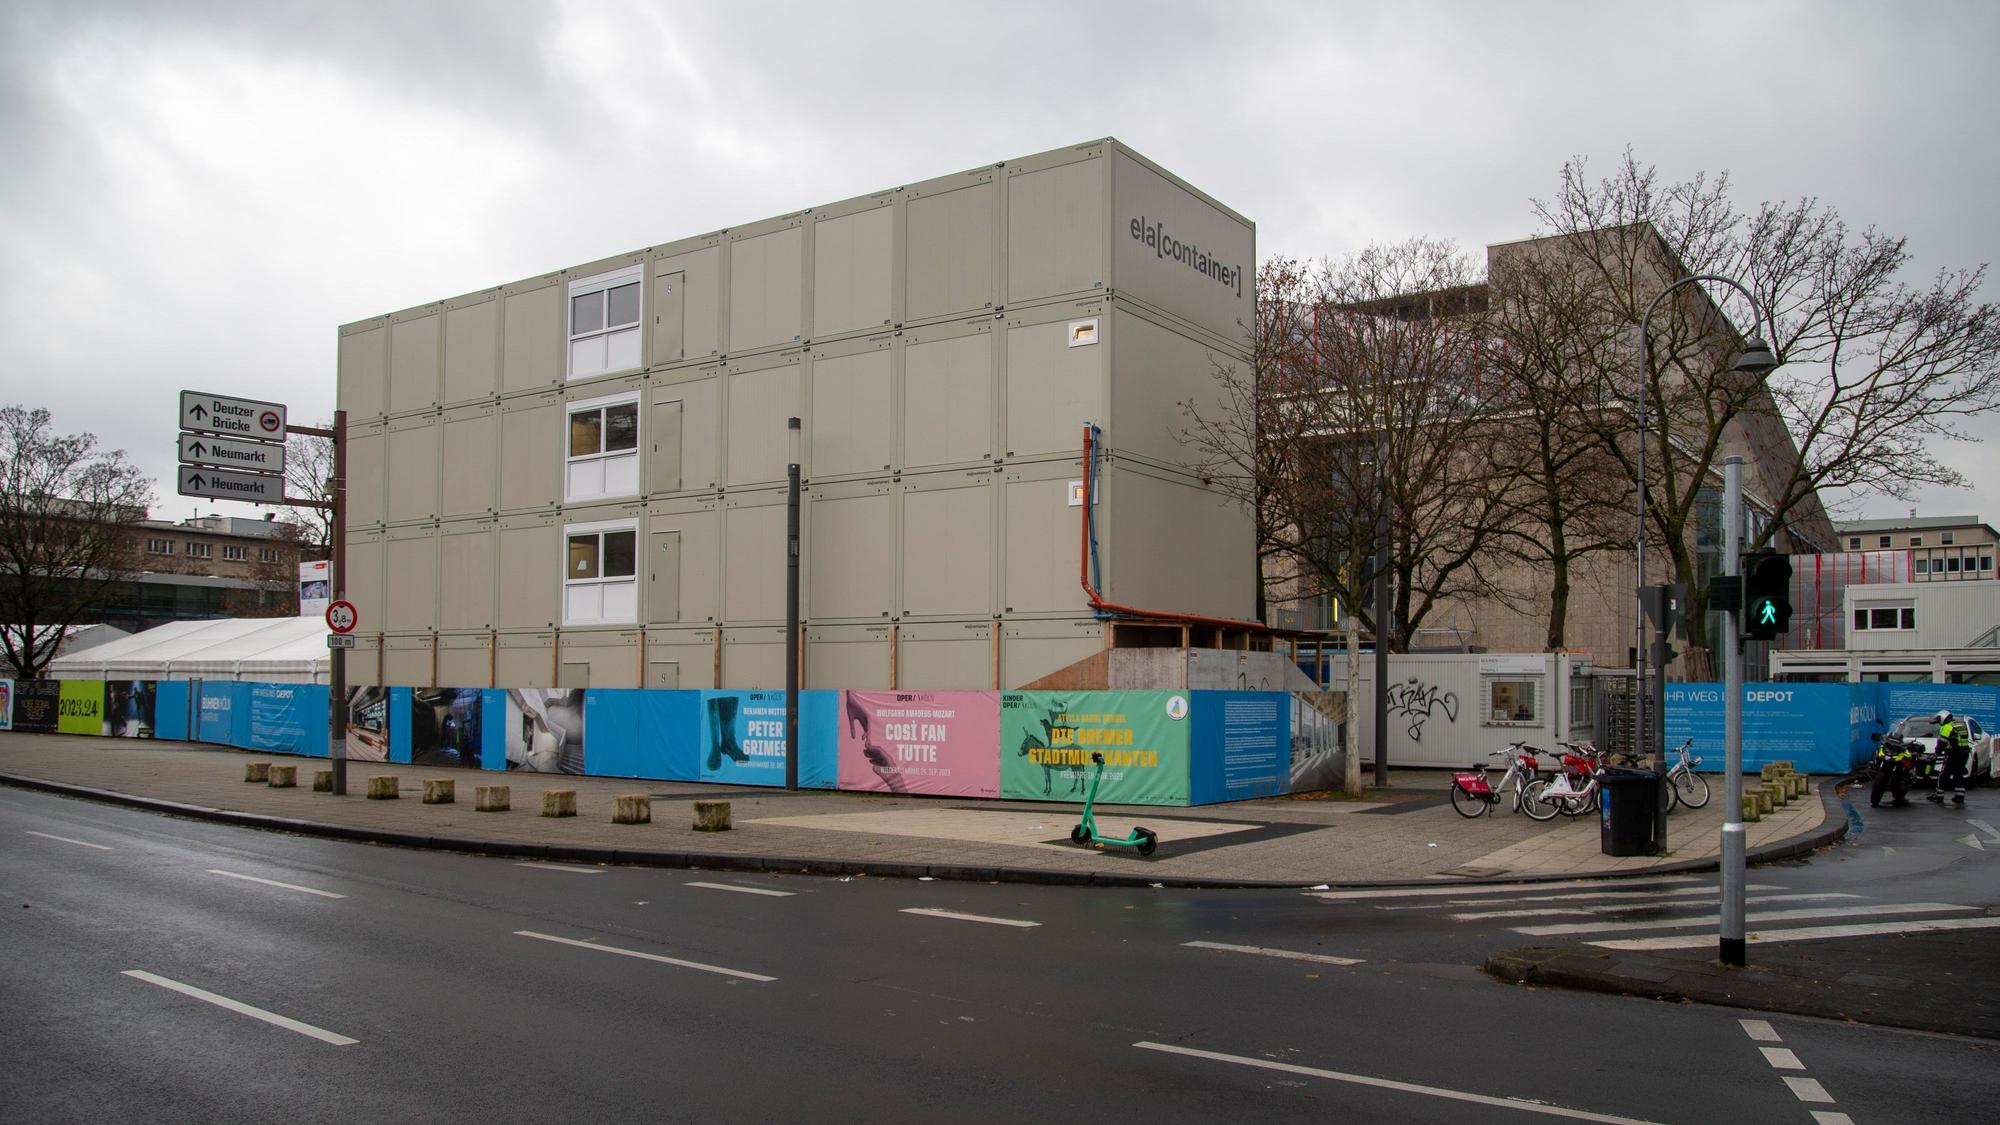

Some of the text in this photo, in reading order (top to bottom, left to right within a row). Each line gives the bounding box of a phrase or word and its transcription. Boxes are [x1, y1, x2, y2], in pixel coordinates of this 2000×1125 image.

[1130, 215, 1241, 298] ela[container]
[213, 401, 255, 418] Deutzer
[213, 416, 250, 432] Brücke
[212, 445, 266, 463] Neumarkt
[211, 477, 265, 494] Heumarkt
[331, 637, 352, 646] 100 m
[1688, 691, 1719, 702] WEG
[1746, 691, 1794, 702] DEPOT
[59, 699, 97, 717] 2023.24
[768, 707, 786, 716] BRITTE
[876, 709, 955, 718] WOLFGANG AMADEUS MOZART
[748, 721, 783, 738] PETER
[921, 725, 946, 742] FAN
[1051, 728, 1133, 746] DIE BREMER
[743, 739, 787, 757] GRIMES
[897, 744, 937, 763] TUTTE
[1028, 748, 1158, 768] STADTMUKANTEN
